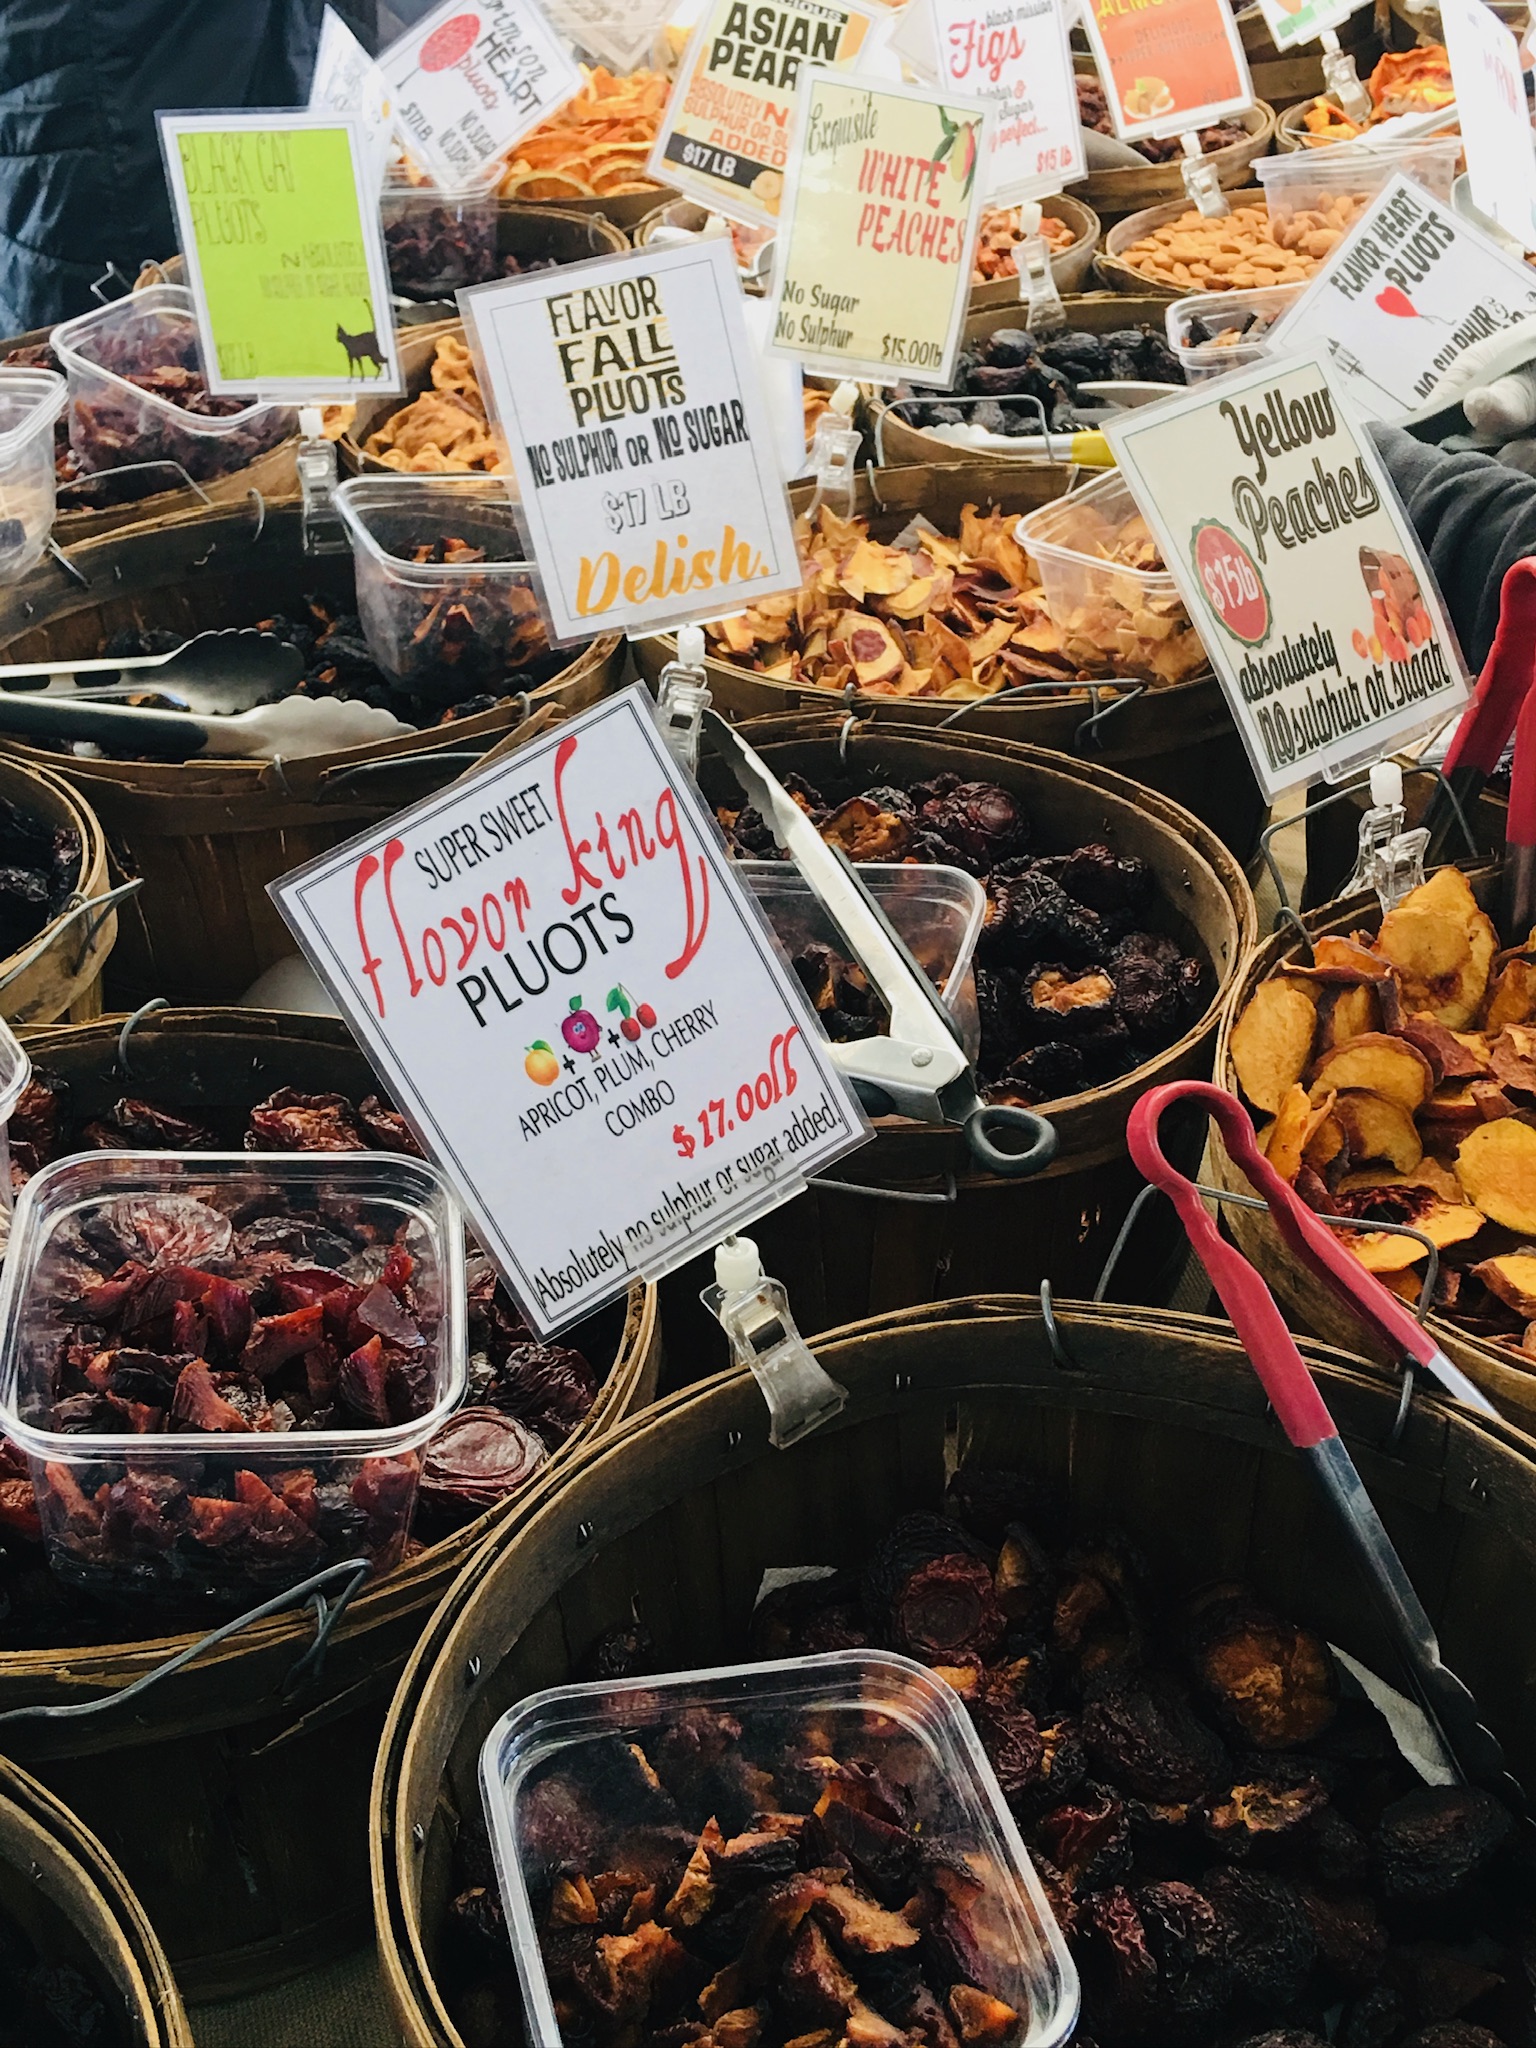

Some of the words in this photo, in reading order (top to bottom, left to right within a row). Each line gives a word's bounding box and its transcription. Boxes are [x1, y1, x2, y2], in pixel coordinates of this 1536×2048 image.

[722, 2, 841, 61] ASIAN
[948, 18, 1026, 82] Figs
[476, 32, 541, 114] HEART
[708, 38, 827, 91] PEAR
[682, 97, 748, 134] SULPHUR
[808, 92, 878, 164] Exquisite
[256, 131, 296, 193] CAT
[683, 143, 712, 167] $17
[711, 152, 738, 178] LB
[708, 129, 788, 166] ADDED
[859, 148, 947, 209] WHITE
[1036, 148, 1058, 174] $15
[189, 198, 268, 246] PLUOTS
[857, 203, 967, 264] PEACHES
[1330, 238, 1391, 300] FLAVOR
[1371, 188, 1422, 249] HEART
[1385, 211, 1455, 295] PLUOTS
[546, 276, 663, 337] FLAVOR
[782, 280, 805, 305] No
[811, 284, 860, 317] Sugar
[558, 323, 677, 384] FALL
[775, 311, 795, 340] No
[800, 313, 854, 349] Sulphur
[570, 366, 687, 428] PLUOTS
[525, 443, 555, 489] NO
[552, 427, 623, 480] SULPHUR
[625, 434, 653, 467] OR
[652, 415, 685, 461] NO
[683, 399, 751, 452] SUGAR
[1219, 388, 1337, 486] Yellow
[603, 490, 647, 535] $17
[652, 480, 691, 520] LB
[1231, 457, 1381, 565] Peaches
[576, 525, 770, 617] Delish.
[1365, 664, 1396, 718] or
[1390, 638, 1451, 707] sugar
[414, 823, 491, 889] SUPER
[479, 783, 554, 853] SWEET
[554, 735, 709, 980] king
[456, 892, 634, 1028] PLUOTS
[517, 1076, 600, 1143] APRICOT,
[593, 1044, 656, 1094] PLUM,
[650, 999, 719, 1058] CHERRY
[604, 1080, 676, 1137] COMBO
[533, 1229, 630, 1313] Absolutely
[624, 1219, 655, 1253] no
[650, 1181, 717, 1234] sulphur
[714, 1165, 739, 1197] or
[735, 1140, 785, 1185] sugar
[782, 1092, 842, 1154] added.
